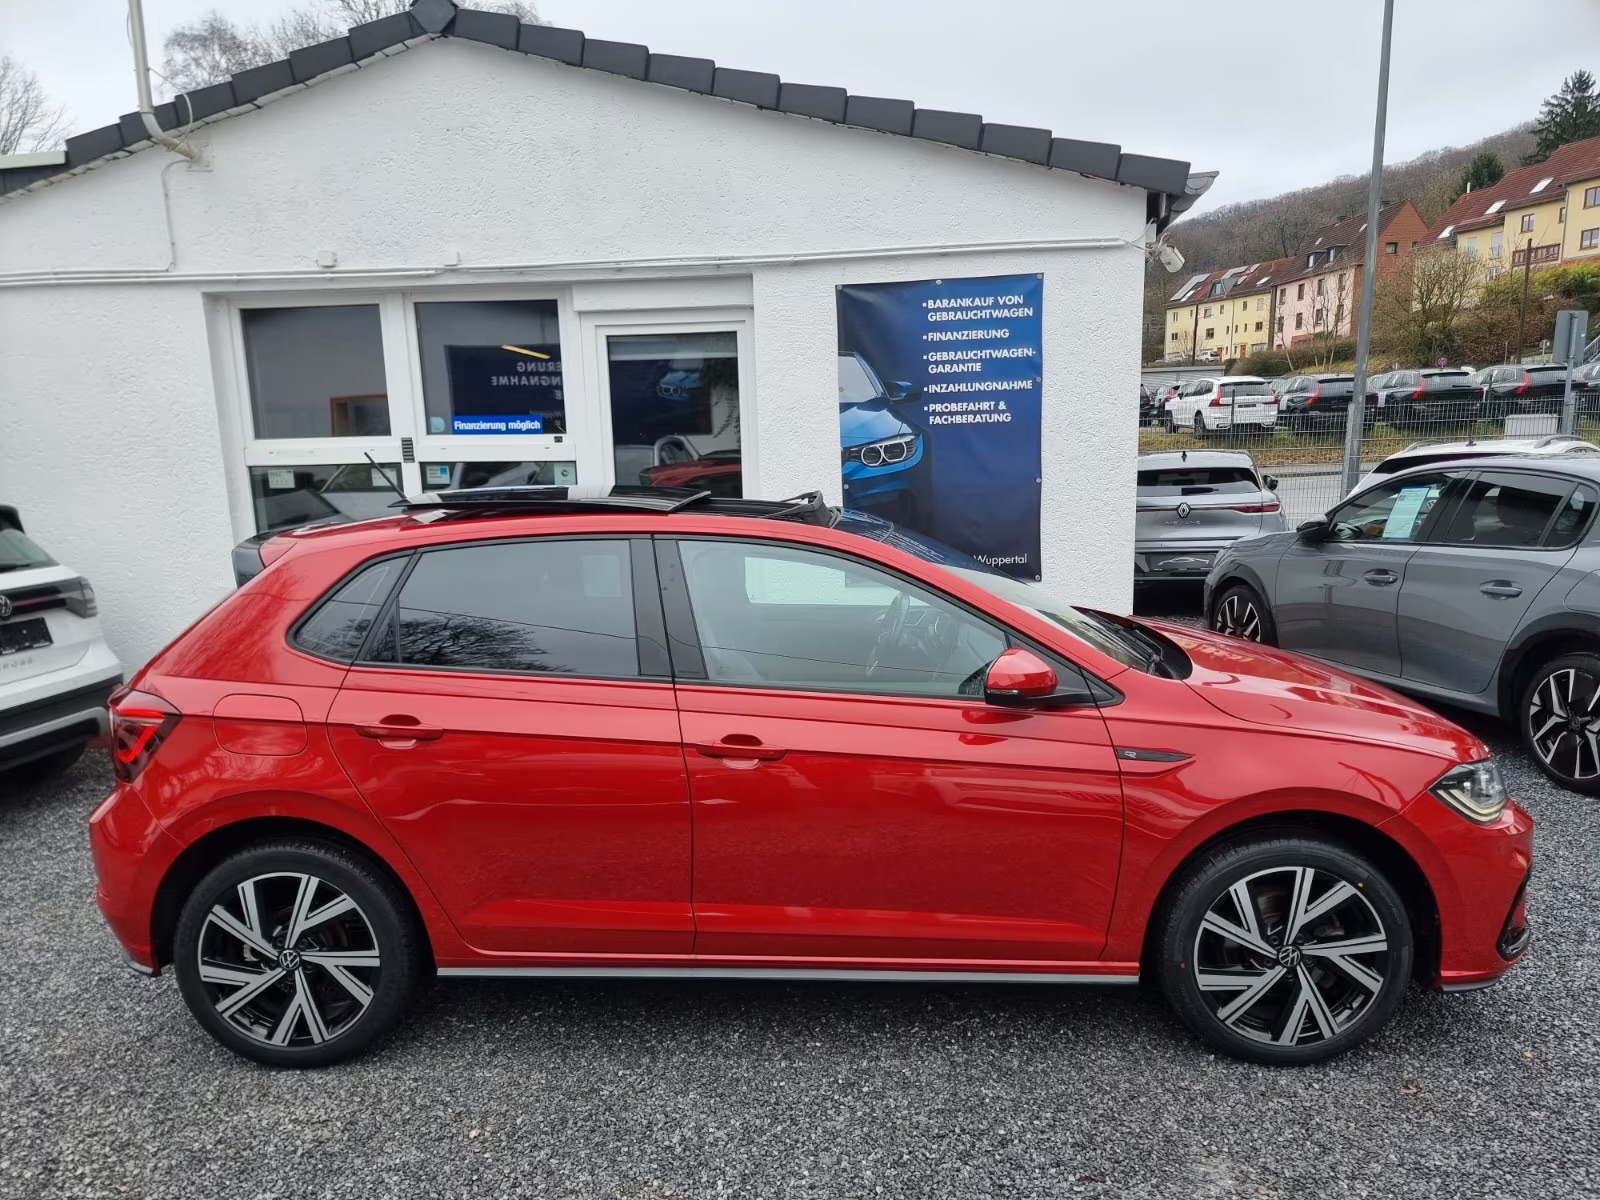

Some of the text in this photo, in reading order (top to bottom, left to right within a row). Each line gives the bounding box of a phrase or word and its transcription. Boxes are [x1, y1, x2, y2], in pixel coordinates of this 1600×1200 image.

[927, 295, 1024, 308] BARANKAUF VON
[927, 307, 1033, 321] GEBRAUCHTWAGEN
[927, 329, 1010, 341] FINANZIERUNG
[928, 348, 1036, 361] GEBRAUCHTWAGEN-
[928, 362, 982, 374] GARANTIE
[928, 380, 1033, 393] INZAHLUNGNAHME
[929, 400, 1007, 413] PROBEFAHRT &
[454, 419, 541, 432] Finanzierung möglich
[929, 413, 1012, 425] FACHBERATUNG
[973, 553, 1028, 566] Wuppertal
